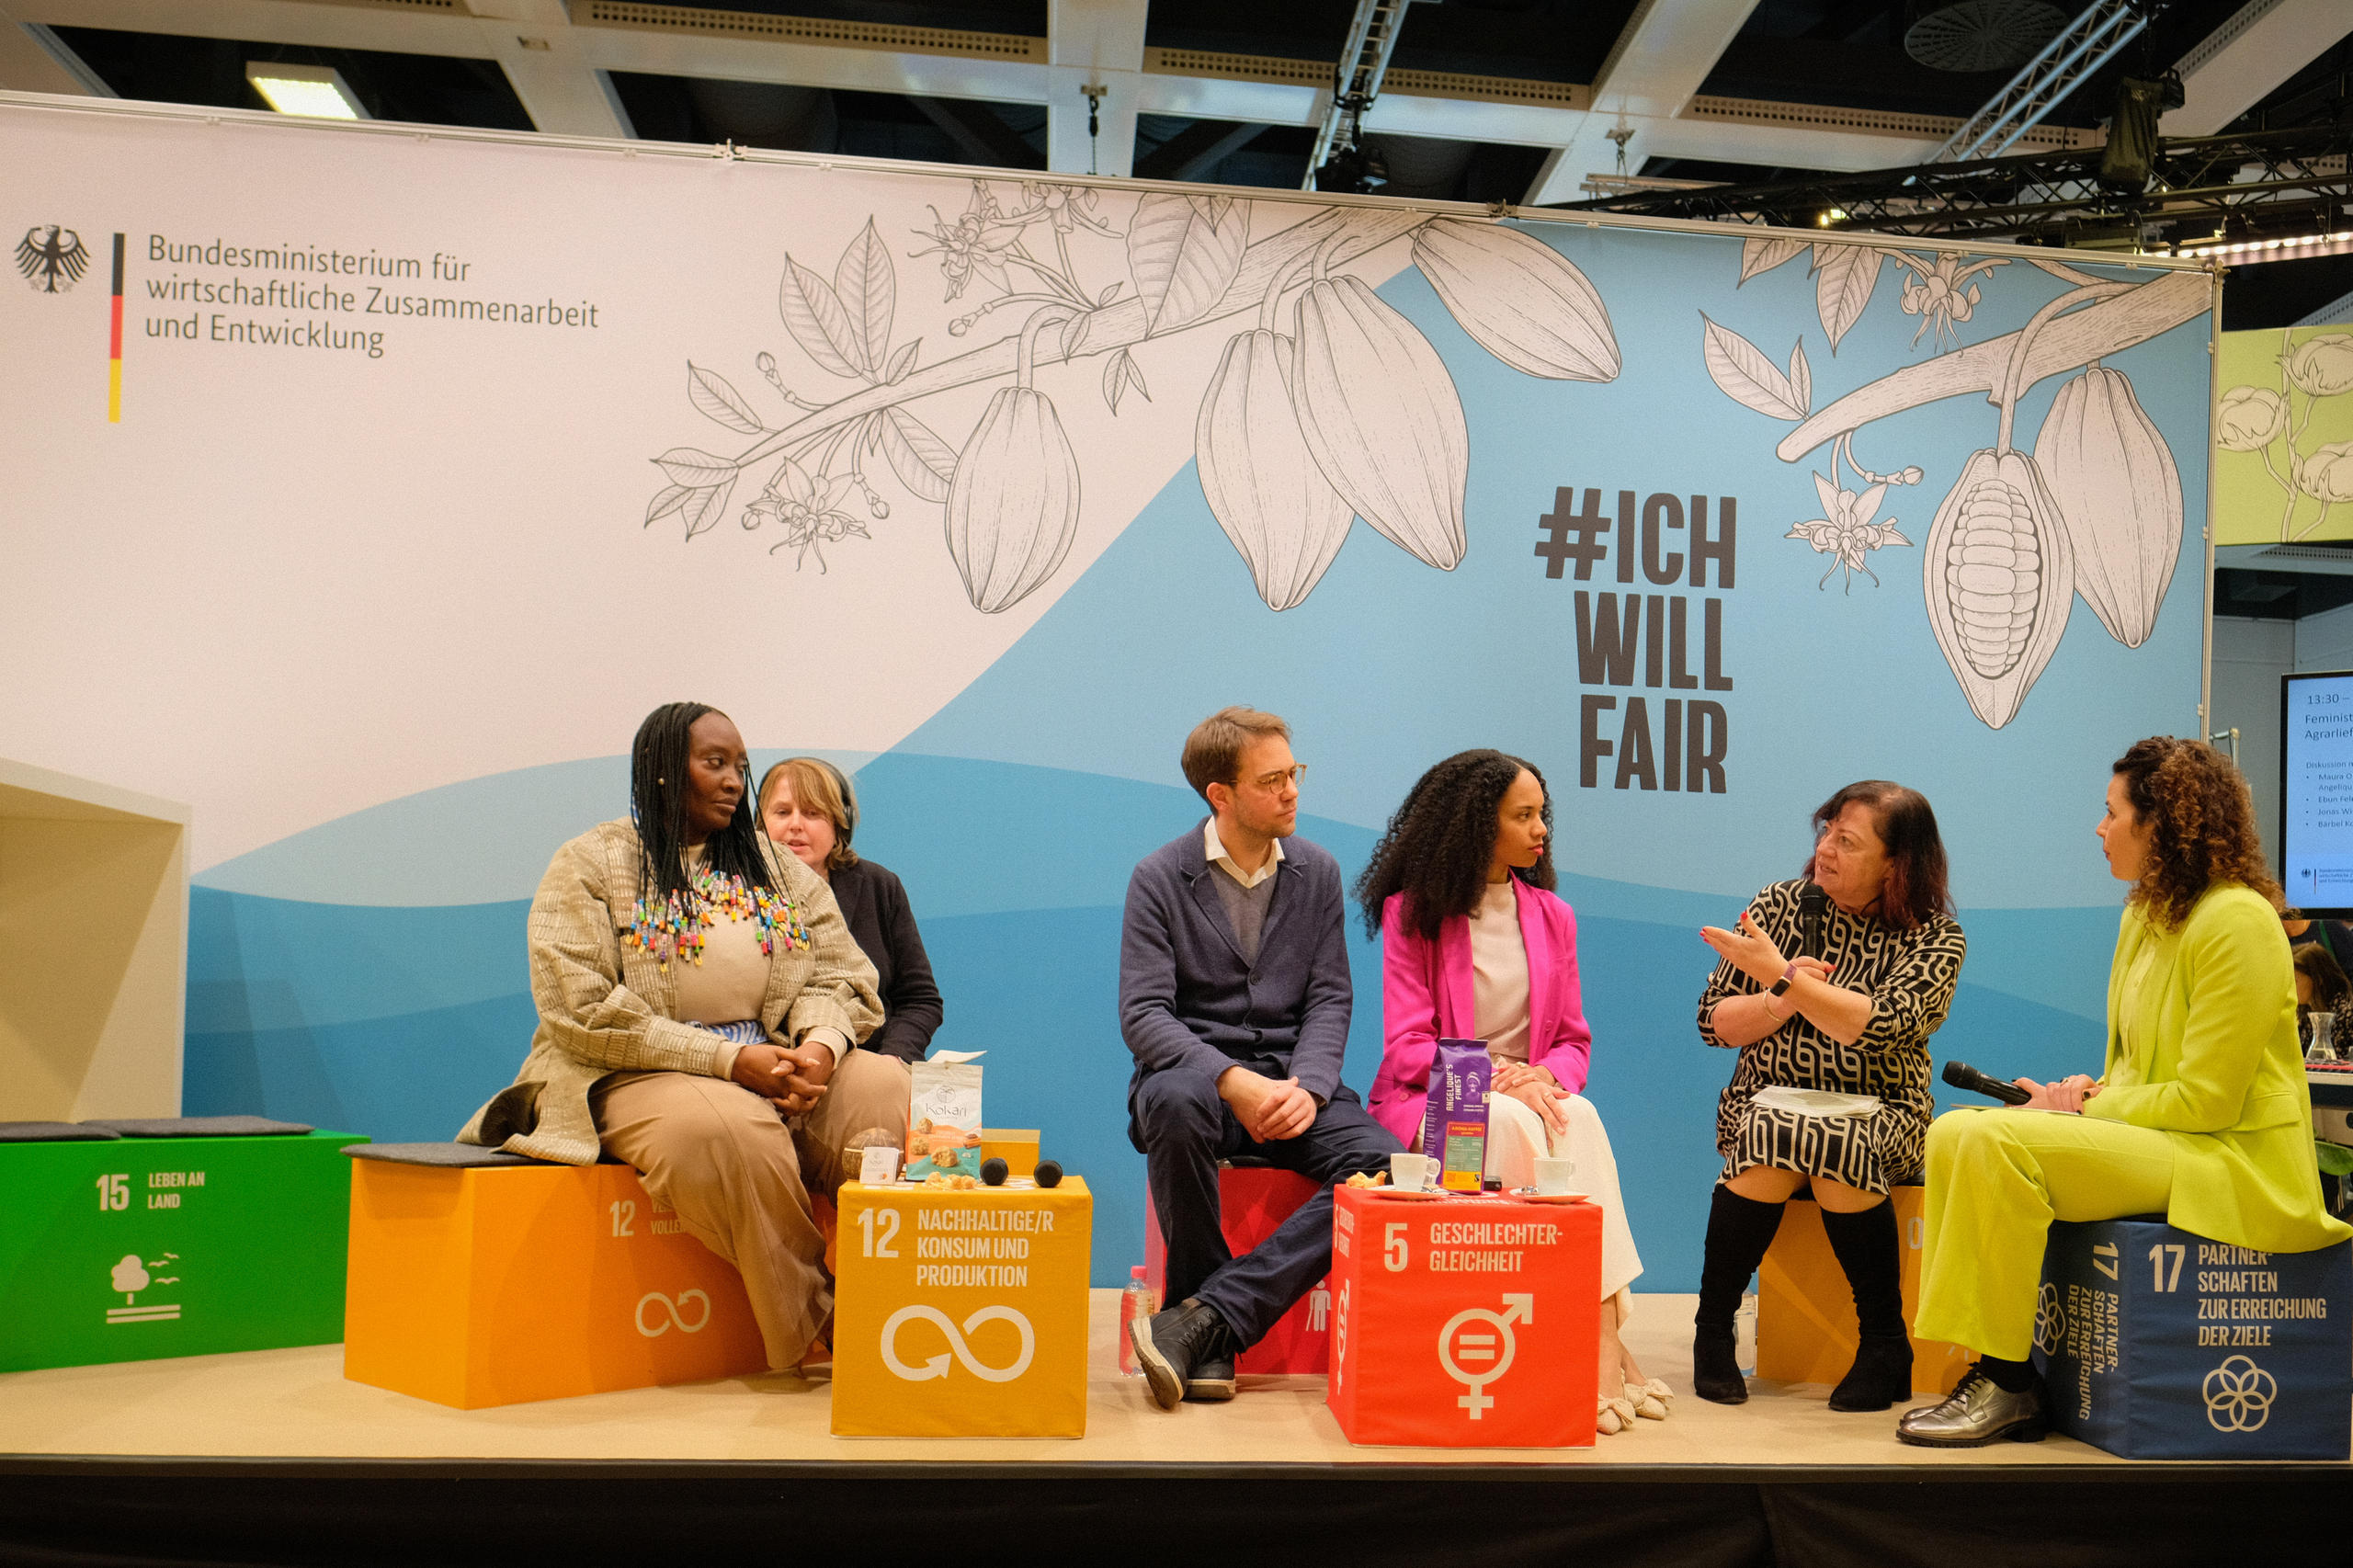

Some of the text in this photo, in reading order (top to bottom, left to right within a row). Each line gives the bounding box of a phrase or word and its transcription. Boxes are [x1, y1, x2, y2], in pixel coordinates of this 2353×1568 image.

[148, 233, 471, 281] Bundesministerium für
[146, 277, 598, 329] wirtschaftliche Zusammenarbeit
[145, 312, 384, 358] und Entwicklung
[1534, 486, 1737, 589] #ICH
[1574, 590, 1733, 692] WILL
[2308, 693, 2339, 705] 13:30
[2305, 713, 2353, 724] Feminist
[1579, 694, 1728, 794] FAIR
[2306, 760, 2347, 769] Diskussion
[1454, 1074, 1462, 1101] FINEST
[96, 1173, 130, 1211] 15
[148, 1171, 205, 1188] LEBEN AN
[147, 1193, 181, 1210] LAND
[609, 1199, 635, 1237] 12
[858, 1208, 900, 1258] 12
[918, 1209, 1054, 1234] NACHHALTIGE/R
[1430, 1222, 1563, 1245] GESCHLECHTER-
[917, 1236, 1029, 1259] KONSUM UND
[1383, 1222, 1409, 1273] 5
[1429, 1250, 1524, 1272] GLEICHHEIT
[2093, 1242, 2120, 1281] 17
[916, 1264, 1028, 1287] PRODUKTION
[2148, 1244, 2186, 1293] 17
[2198, 1271, 2278, 1293] SCHAFTEN
[2067, 1285, 2080, 1359] DER ZIELE
[2198, 1297, 2327, 1320] ZUR ERREICHUNG
[2093, 1290, 2106, 1374] SCHAFTEN
[2106, 1292, 2120, 1373] PARTNER-
[2198, 1324, 2272, 1346] DER ZIELE
[2079, 1287, 2093, 1421] ZUR ERREICHUNG
